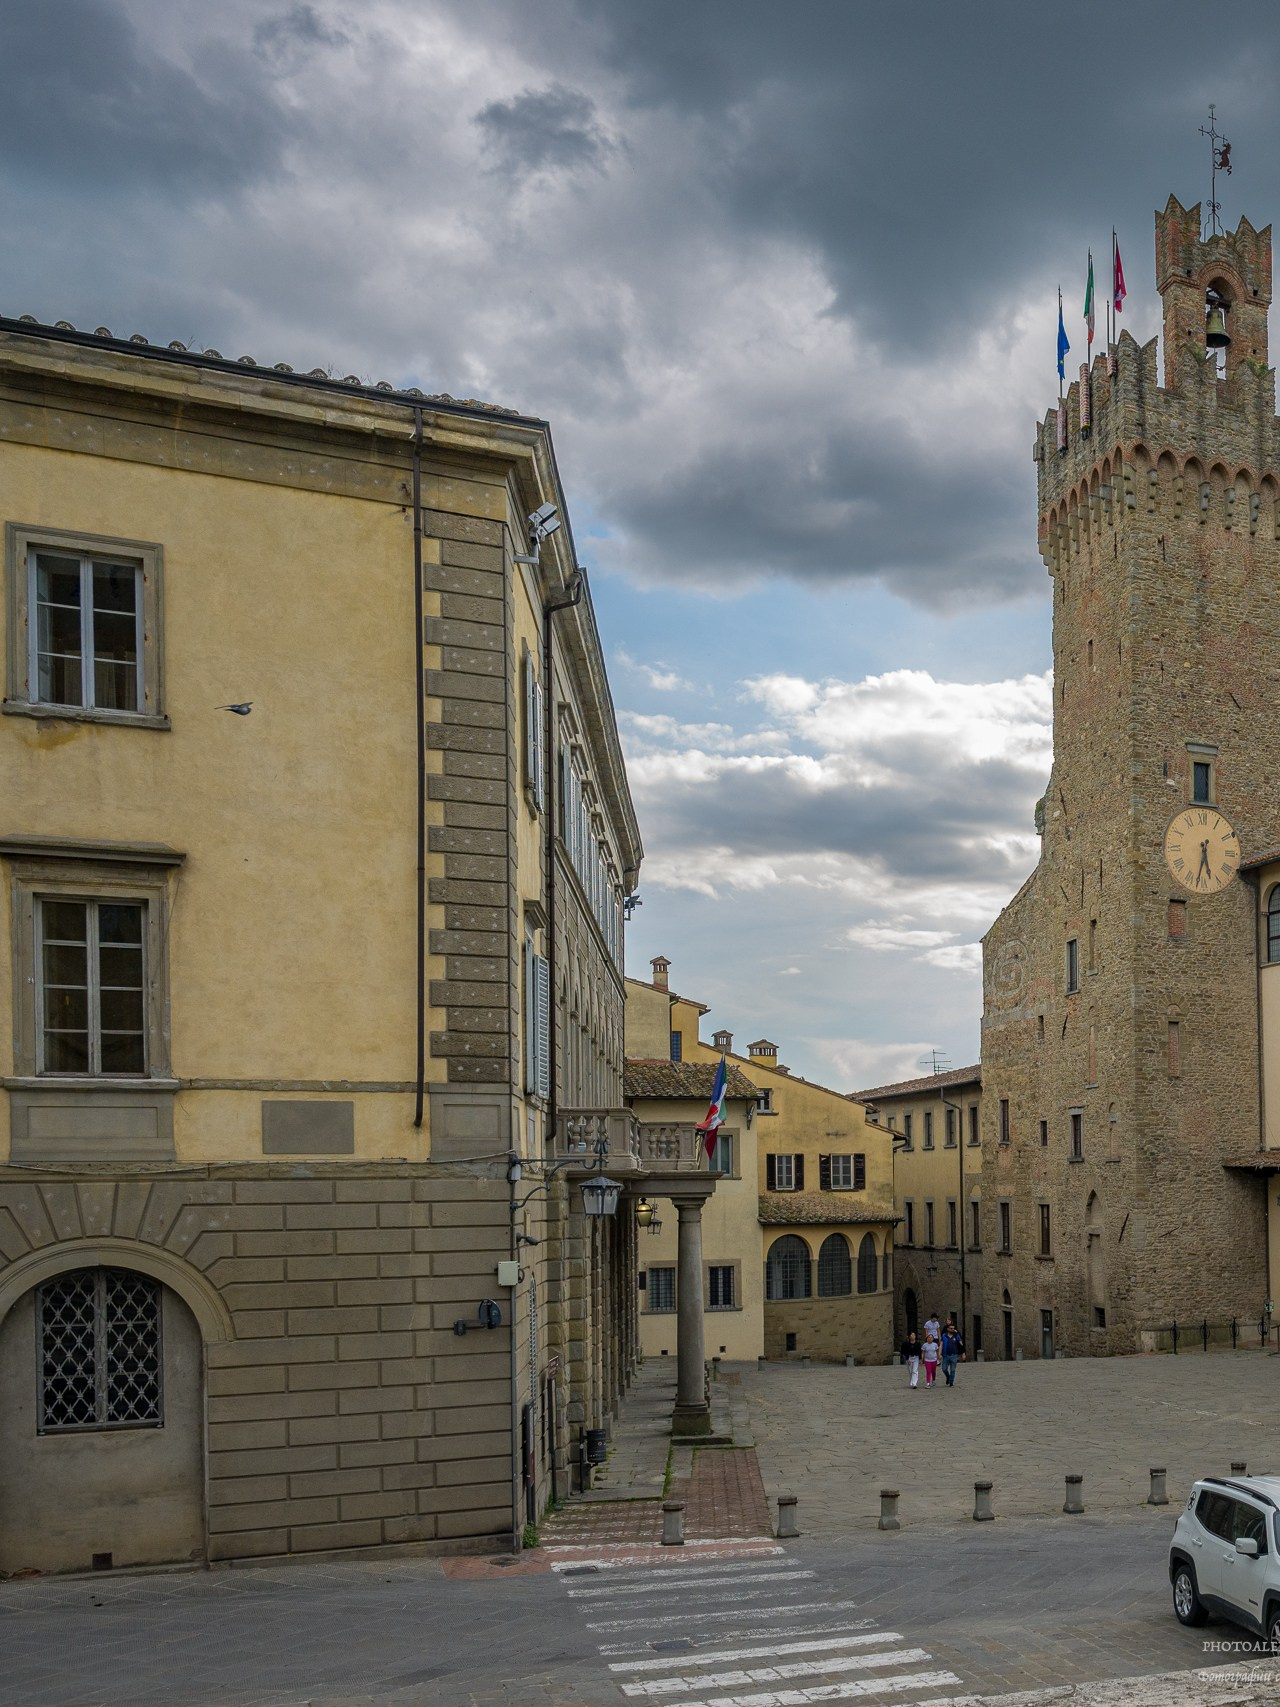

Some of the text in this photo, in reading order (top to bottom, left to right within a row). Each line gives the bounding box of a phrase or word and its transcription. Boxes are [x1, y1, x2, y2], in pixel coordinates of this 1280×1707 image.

[1184, 815, 1194, 829] XI
[1198, 813, 1207, 825] XII
[1221, 833, 1231, 841] II
